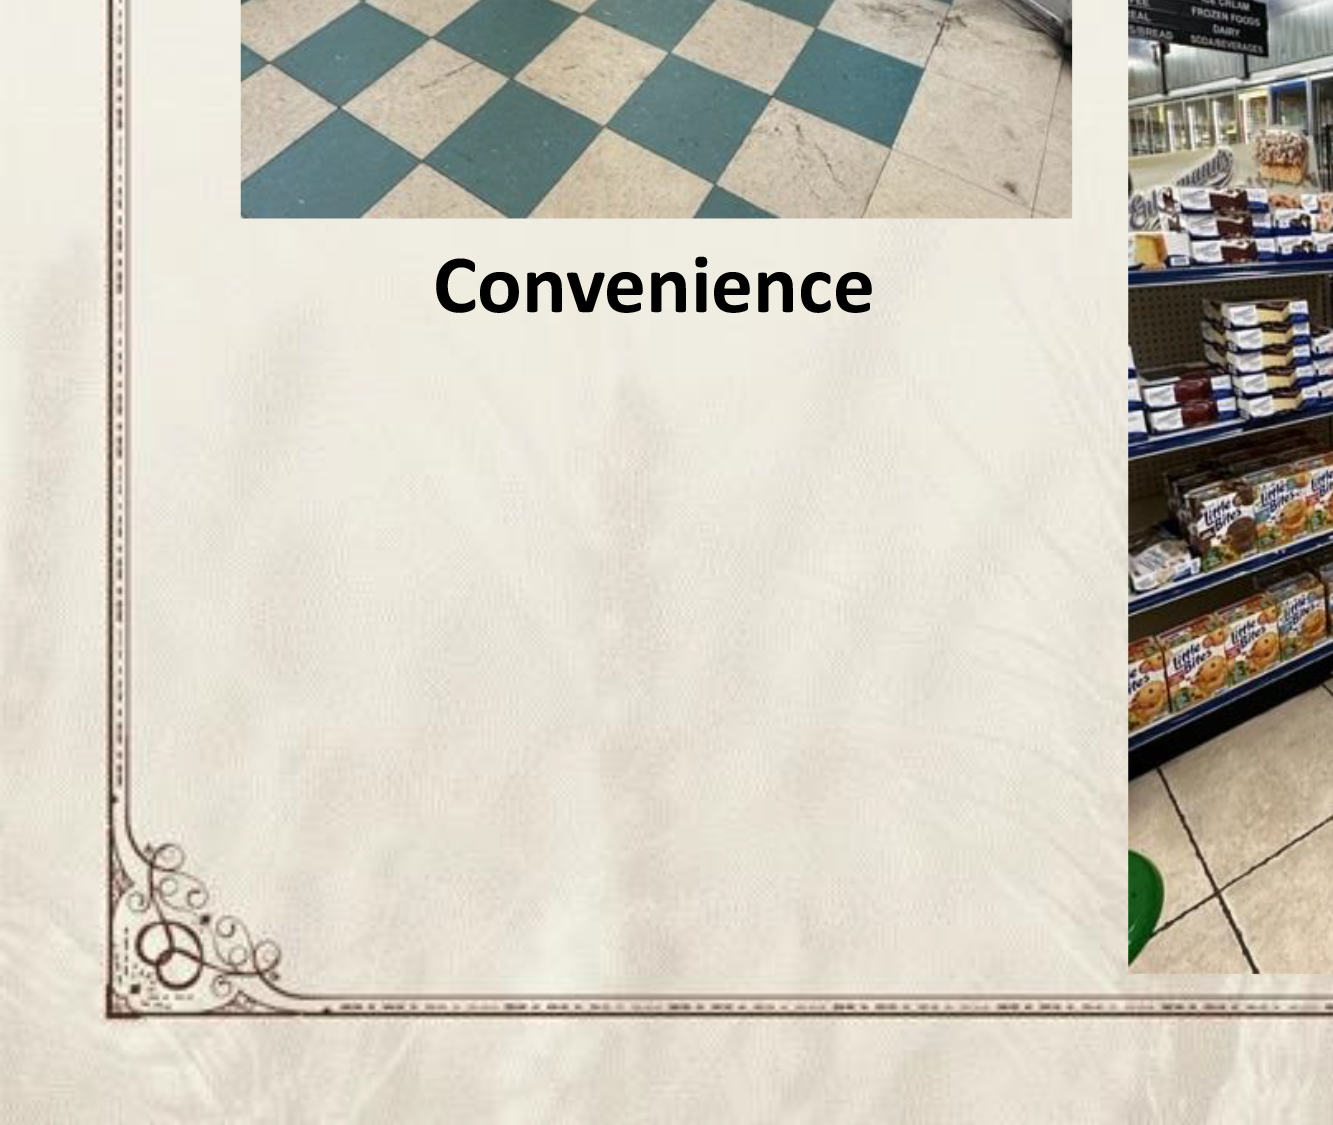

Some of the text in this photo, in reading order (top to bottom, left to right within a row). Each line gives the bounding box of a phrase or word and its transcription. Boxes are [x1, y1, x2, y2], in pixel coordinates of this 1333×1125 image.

[1190, 6, 1261, 28] FROZEN FOODS
[1213, 23, 1241, 38] DAIRY
[1190, 33, 1264, 55] SODA/BEVERAGES
[1172, 643, 1202, 672] Little
[1183, 649, 1213, 675] Bites
